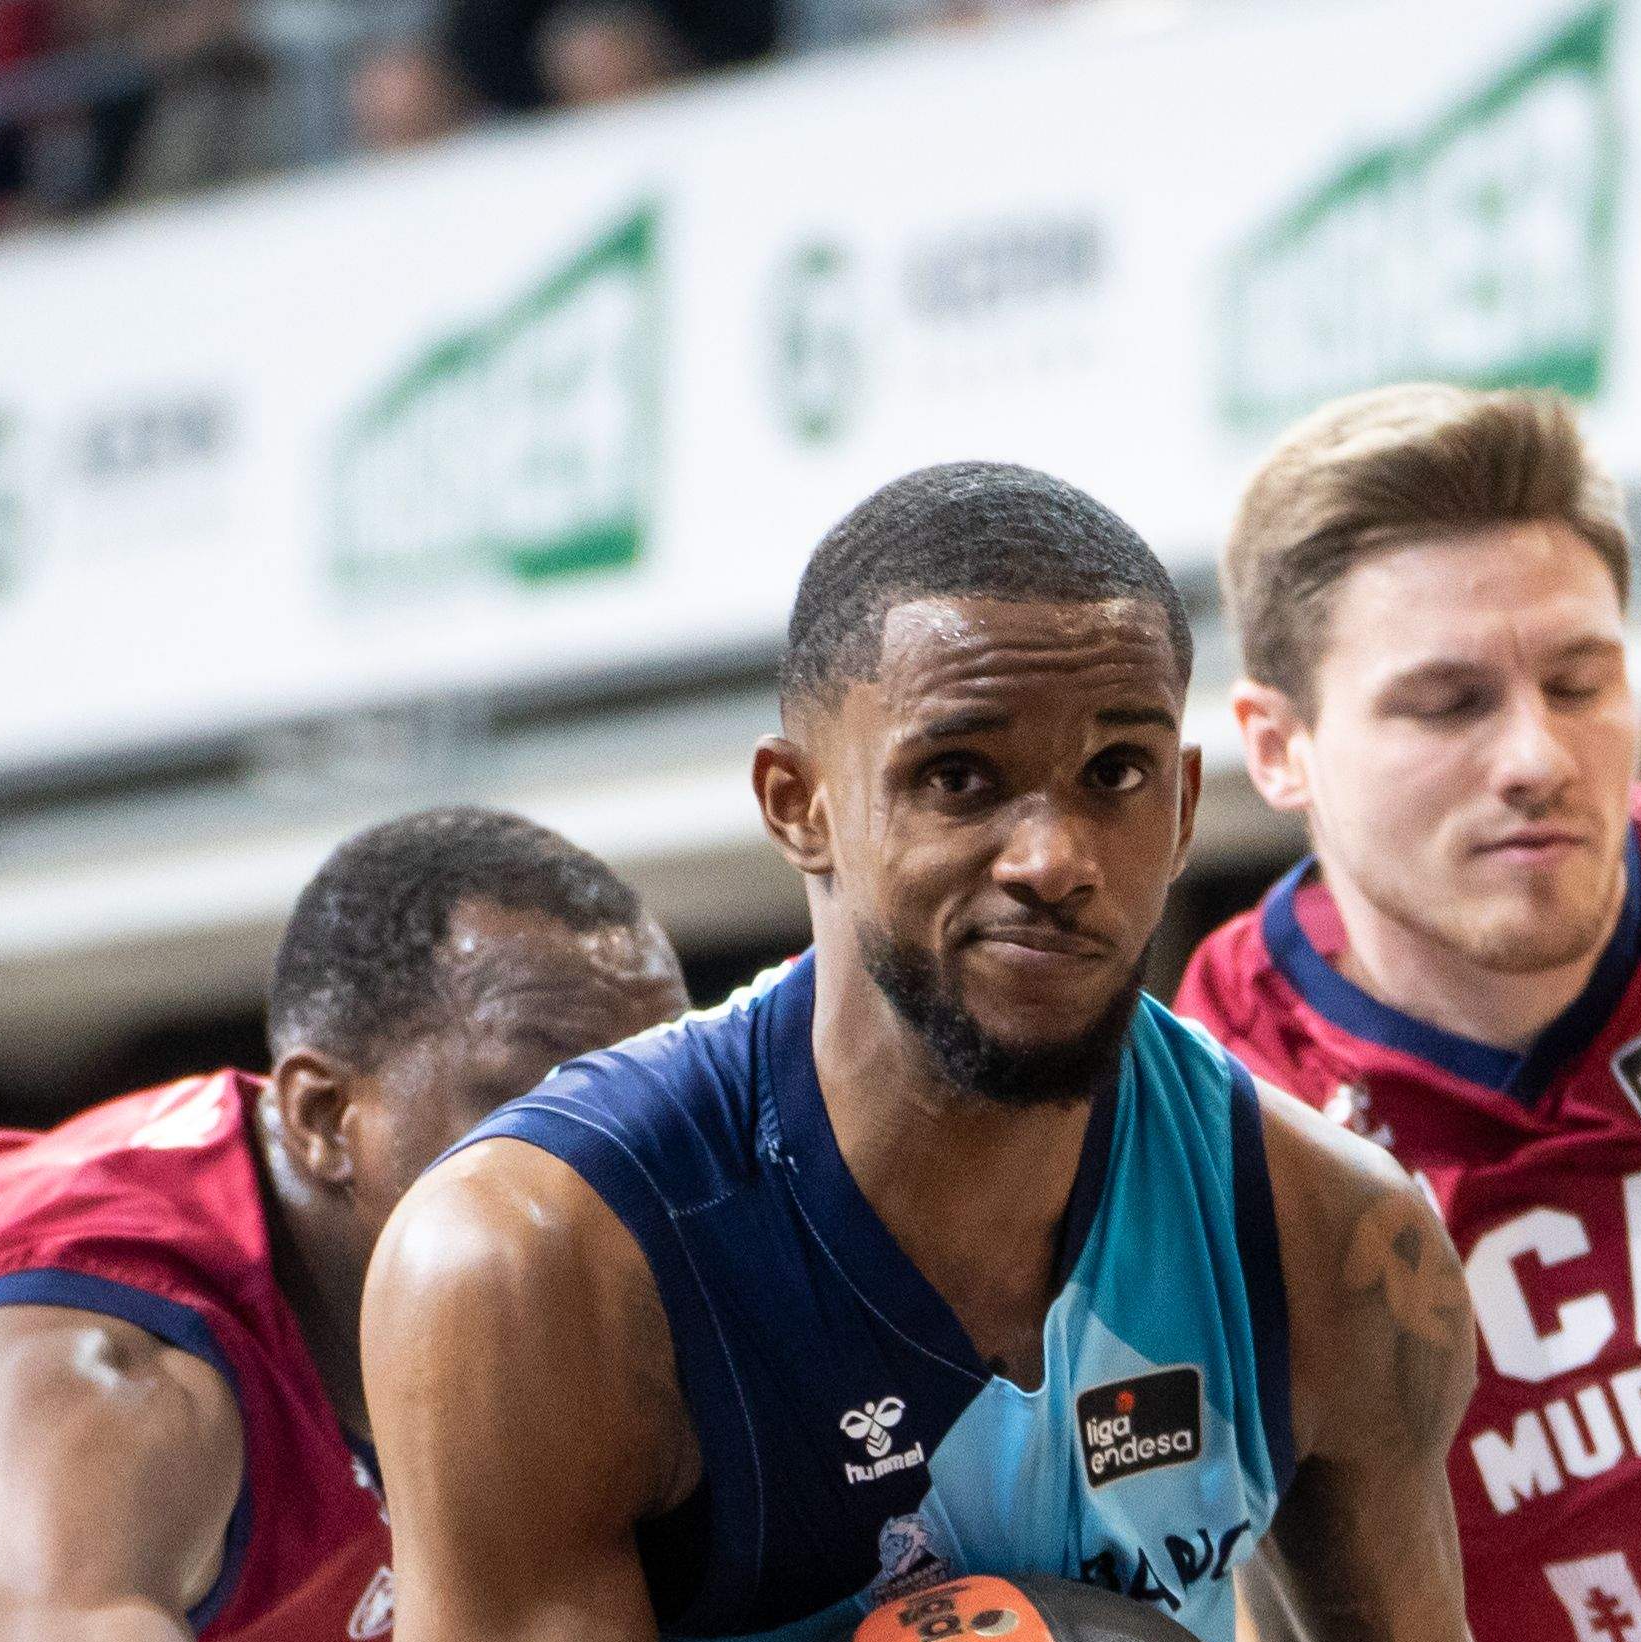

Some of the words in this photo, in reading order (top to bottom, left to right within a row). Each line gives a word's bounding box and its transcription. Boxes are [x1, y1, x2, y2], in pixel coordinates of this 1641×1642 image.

[1086, 1415, 1132, 1448] liga
[1090, 1430, 1193, 1475] endesa
[845, 1441, 926, 1485] hummel
